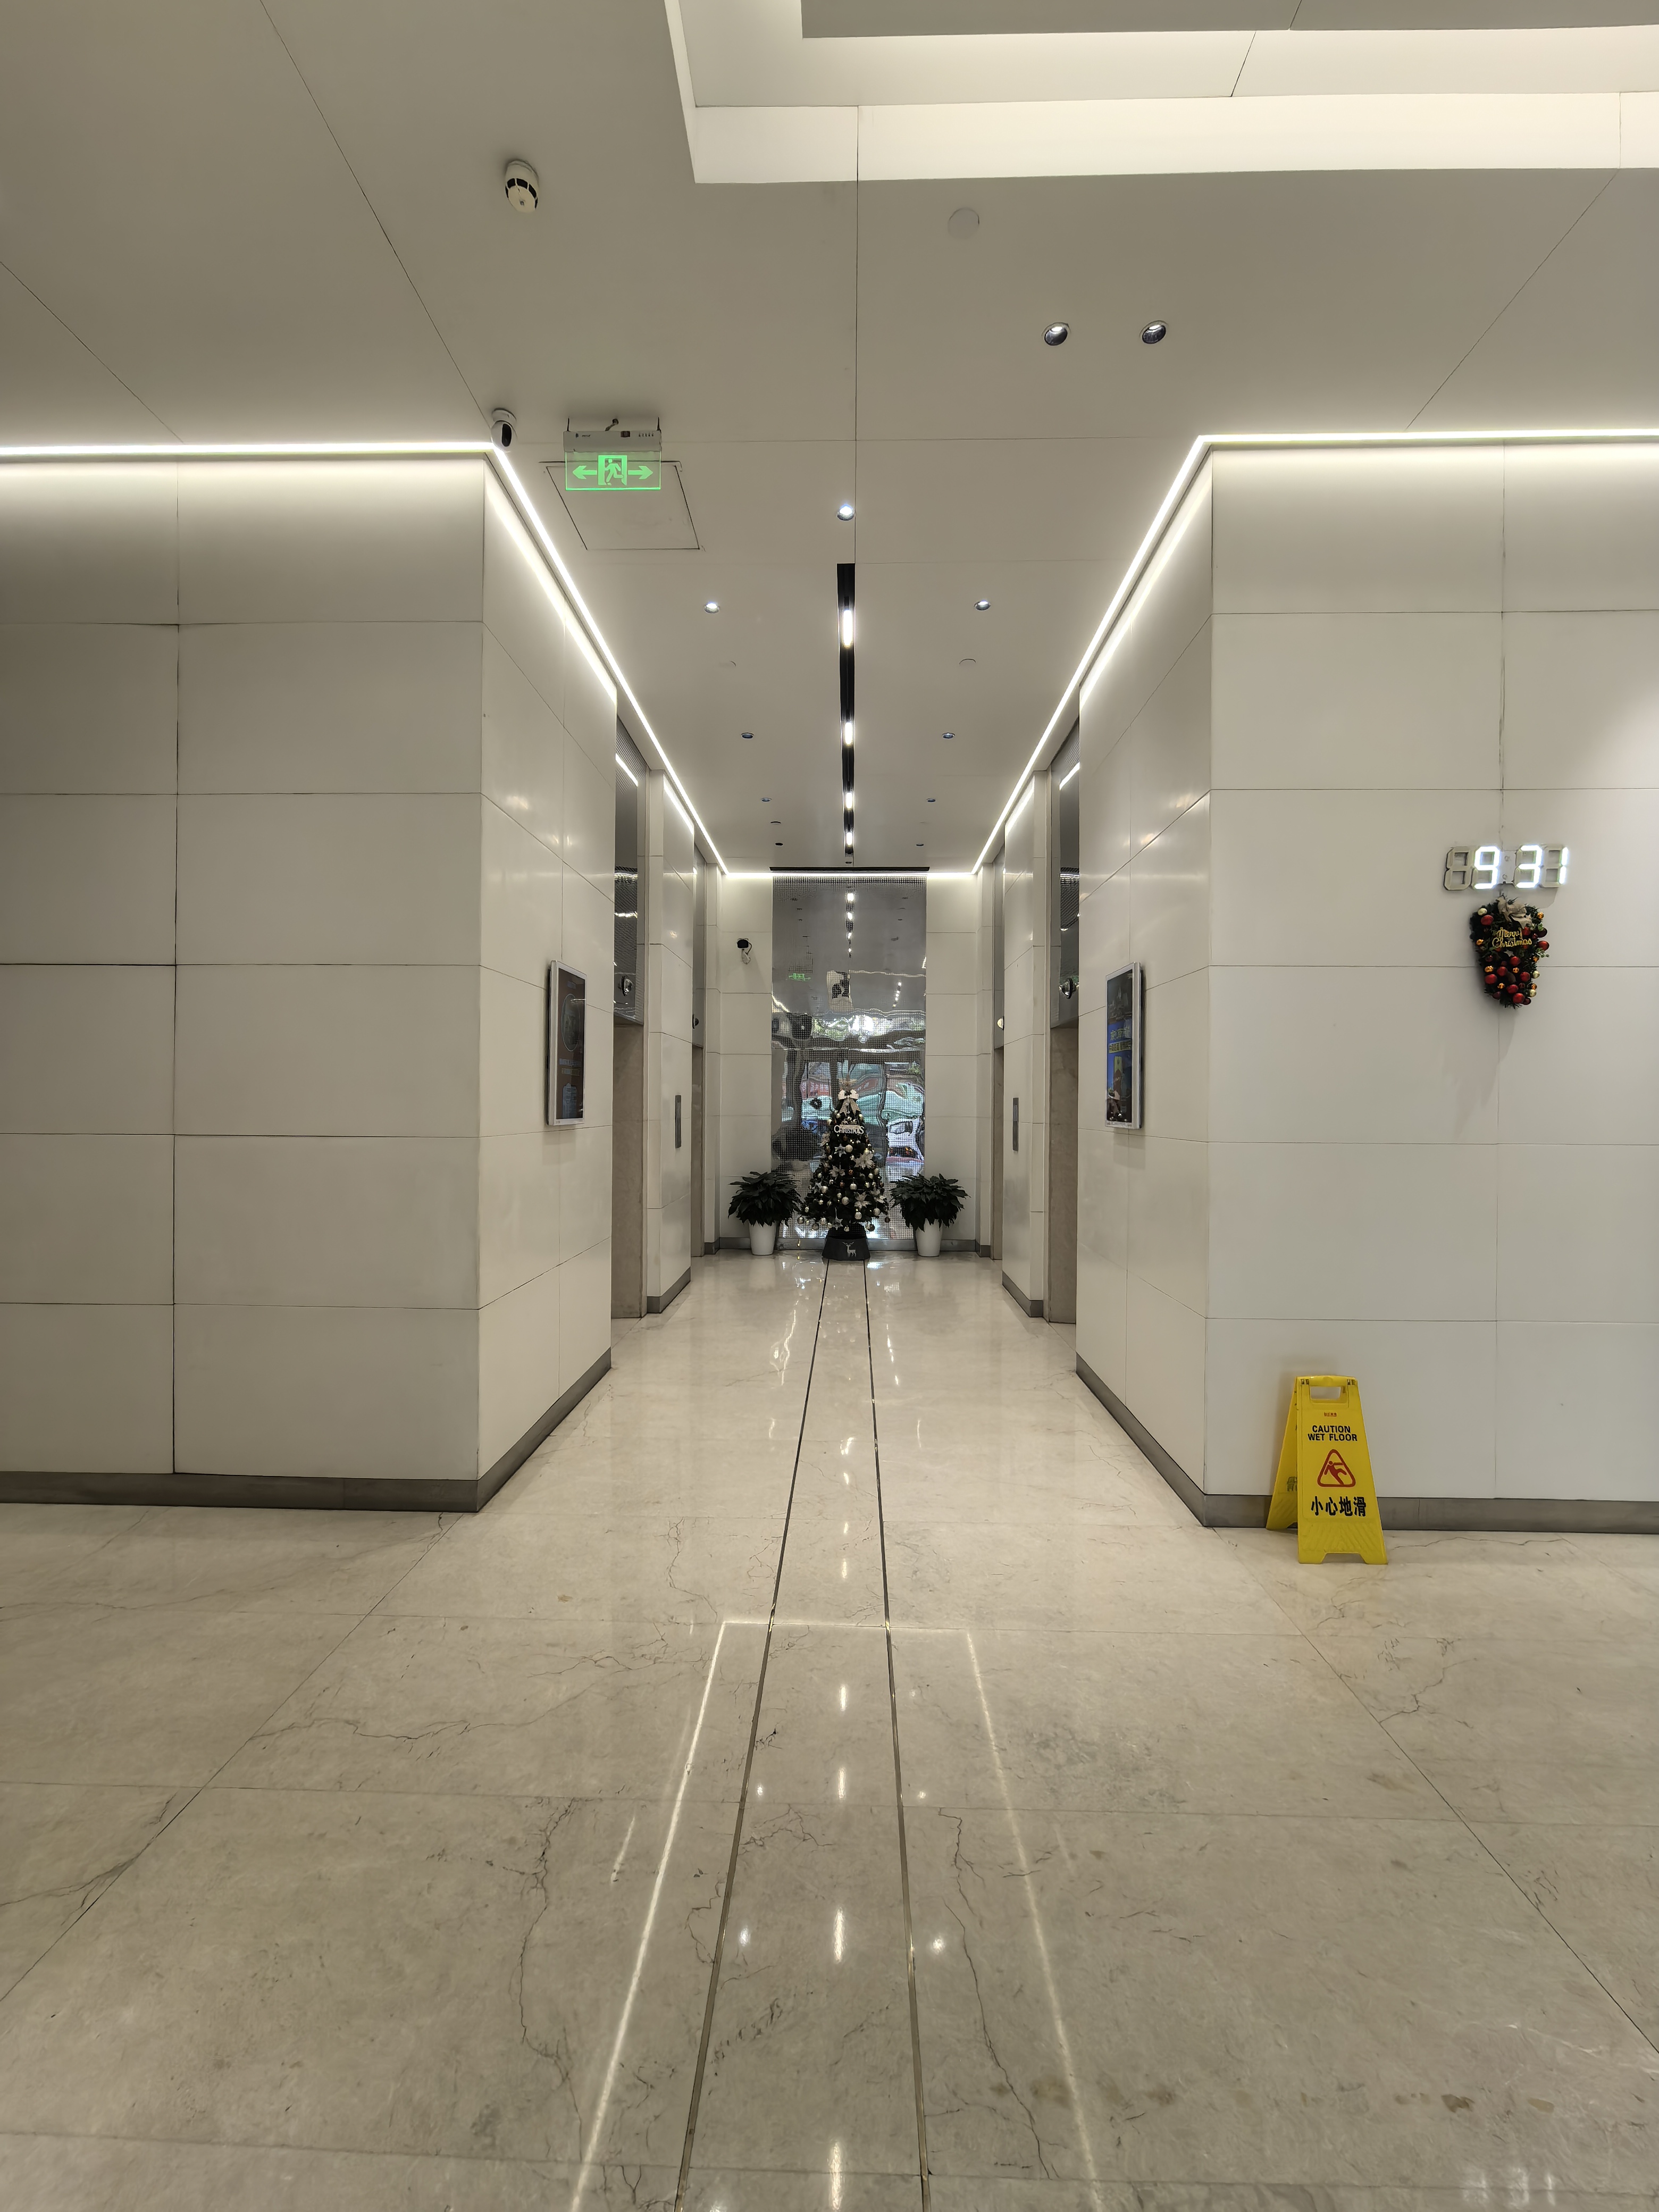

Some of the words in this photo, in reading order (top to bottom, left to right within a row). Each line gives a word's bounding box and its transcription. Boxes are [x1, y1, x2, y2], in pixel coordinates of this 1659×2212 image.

[1496, 927, 1523, 939] Merry
[1492, 937, 1532, 948] Christmas
[1311, 1496, 1366, 1516] 小心地滑
